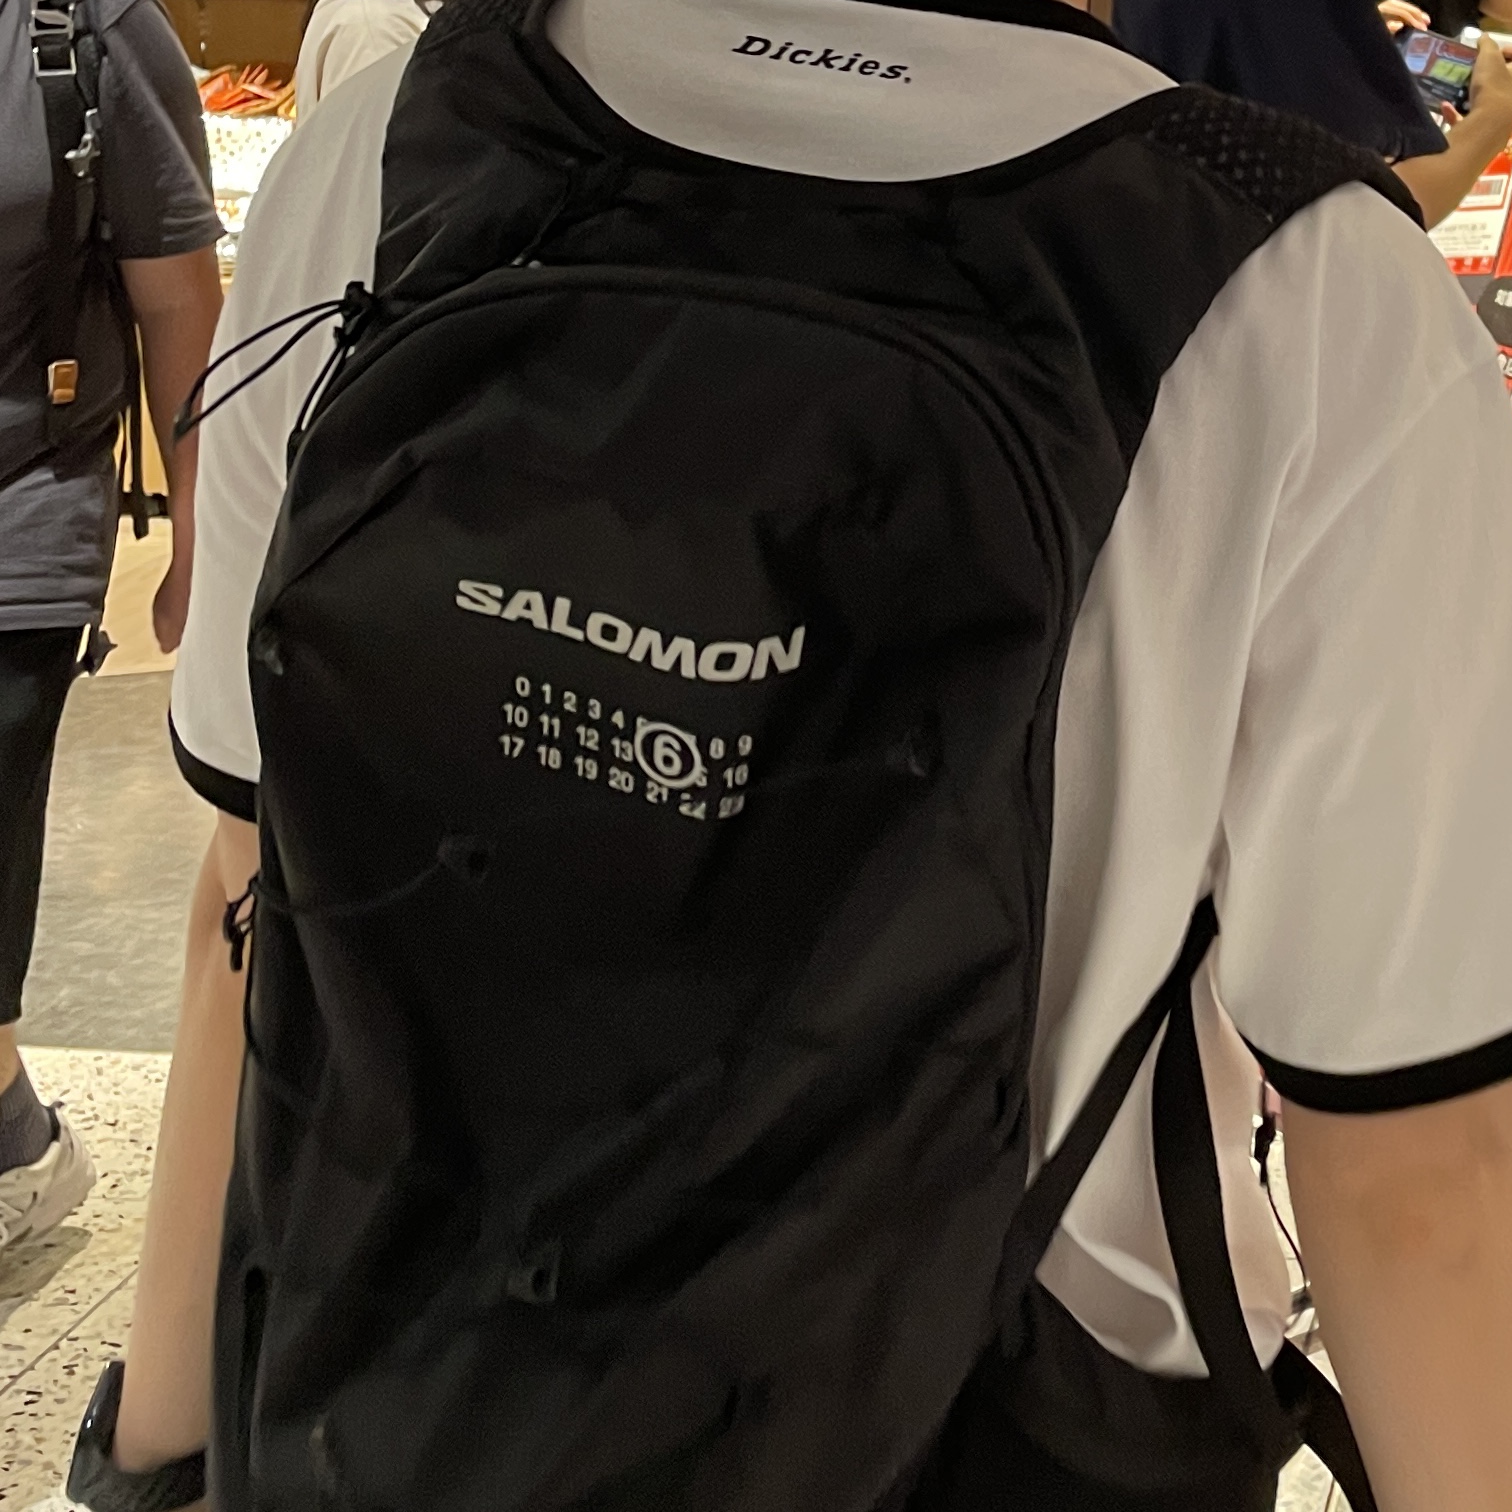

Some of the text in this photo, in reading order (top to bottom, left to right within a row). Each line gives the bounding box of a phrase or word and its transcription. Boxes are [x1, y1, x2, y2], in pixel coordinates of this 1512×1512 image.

[731, 34, 913, 84] Dickies.
[456, 579, 806, 682] SALOMON
[515, 676, 531, 698] 0
[541, 682, 552, 704] 1
[563, 690, 577, 713] 2
[588, 697, 601, 720] 3
[611, 708, 624, 730] 4
[502, 702, 529, 728] 10
[538, 713, 560, 739] 11
[576, 724, 599, 751] 12
[610, 736, 634, 763] 13
[653, 733, 683, 777] 6
[499, 734, 525, 759] 17
[574, 754, 598, 780] 19
[608, 766, 636, 794] 20
